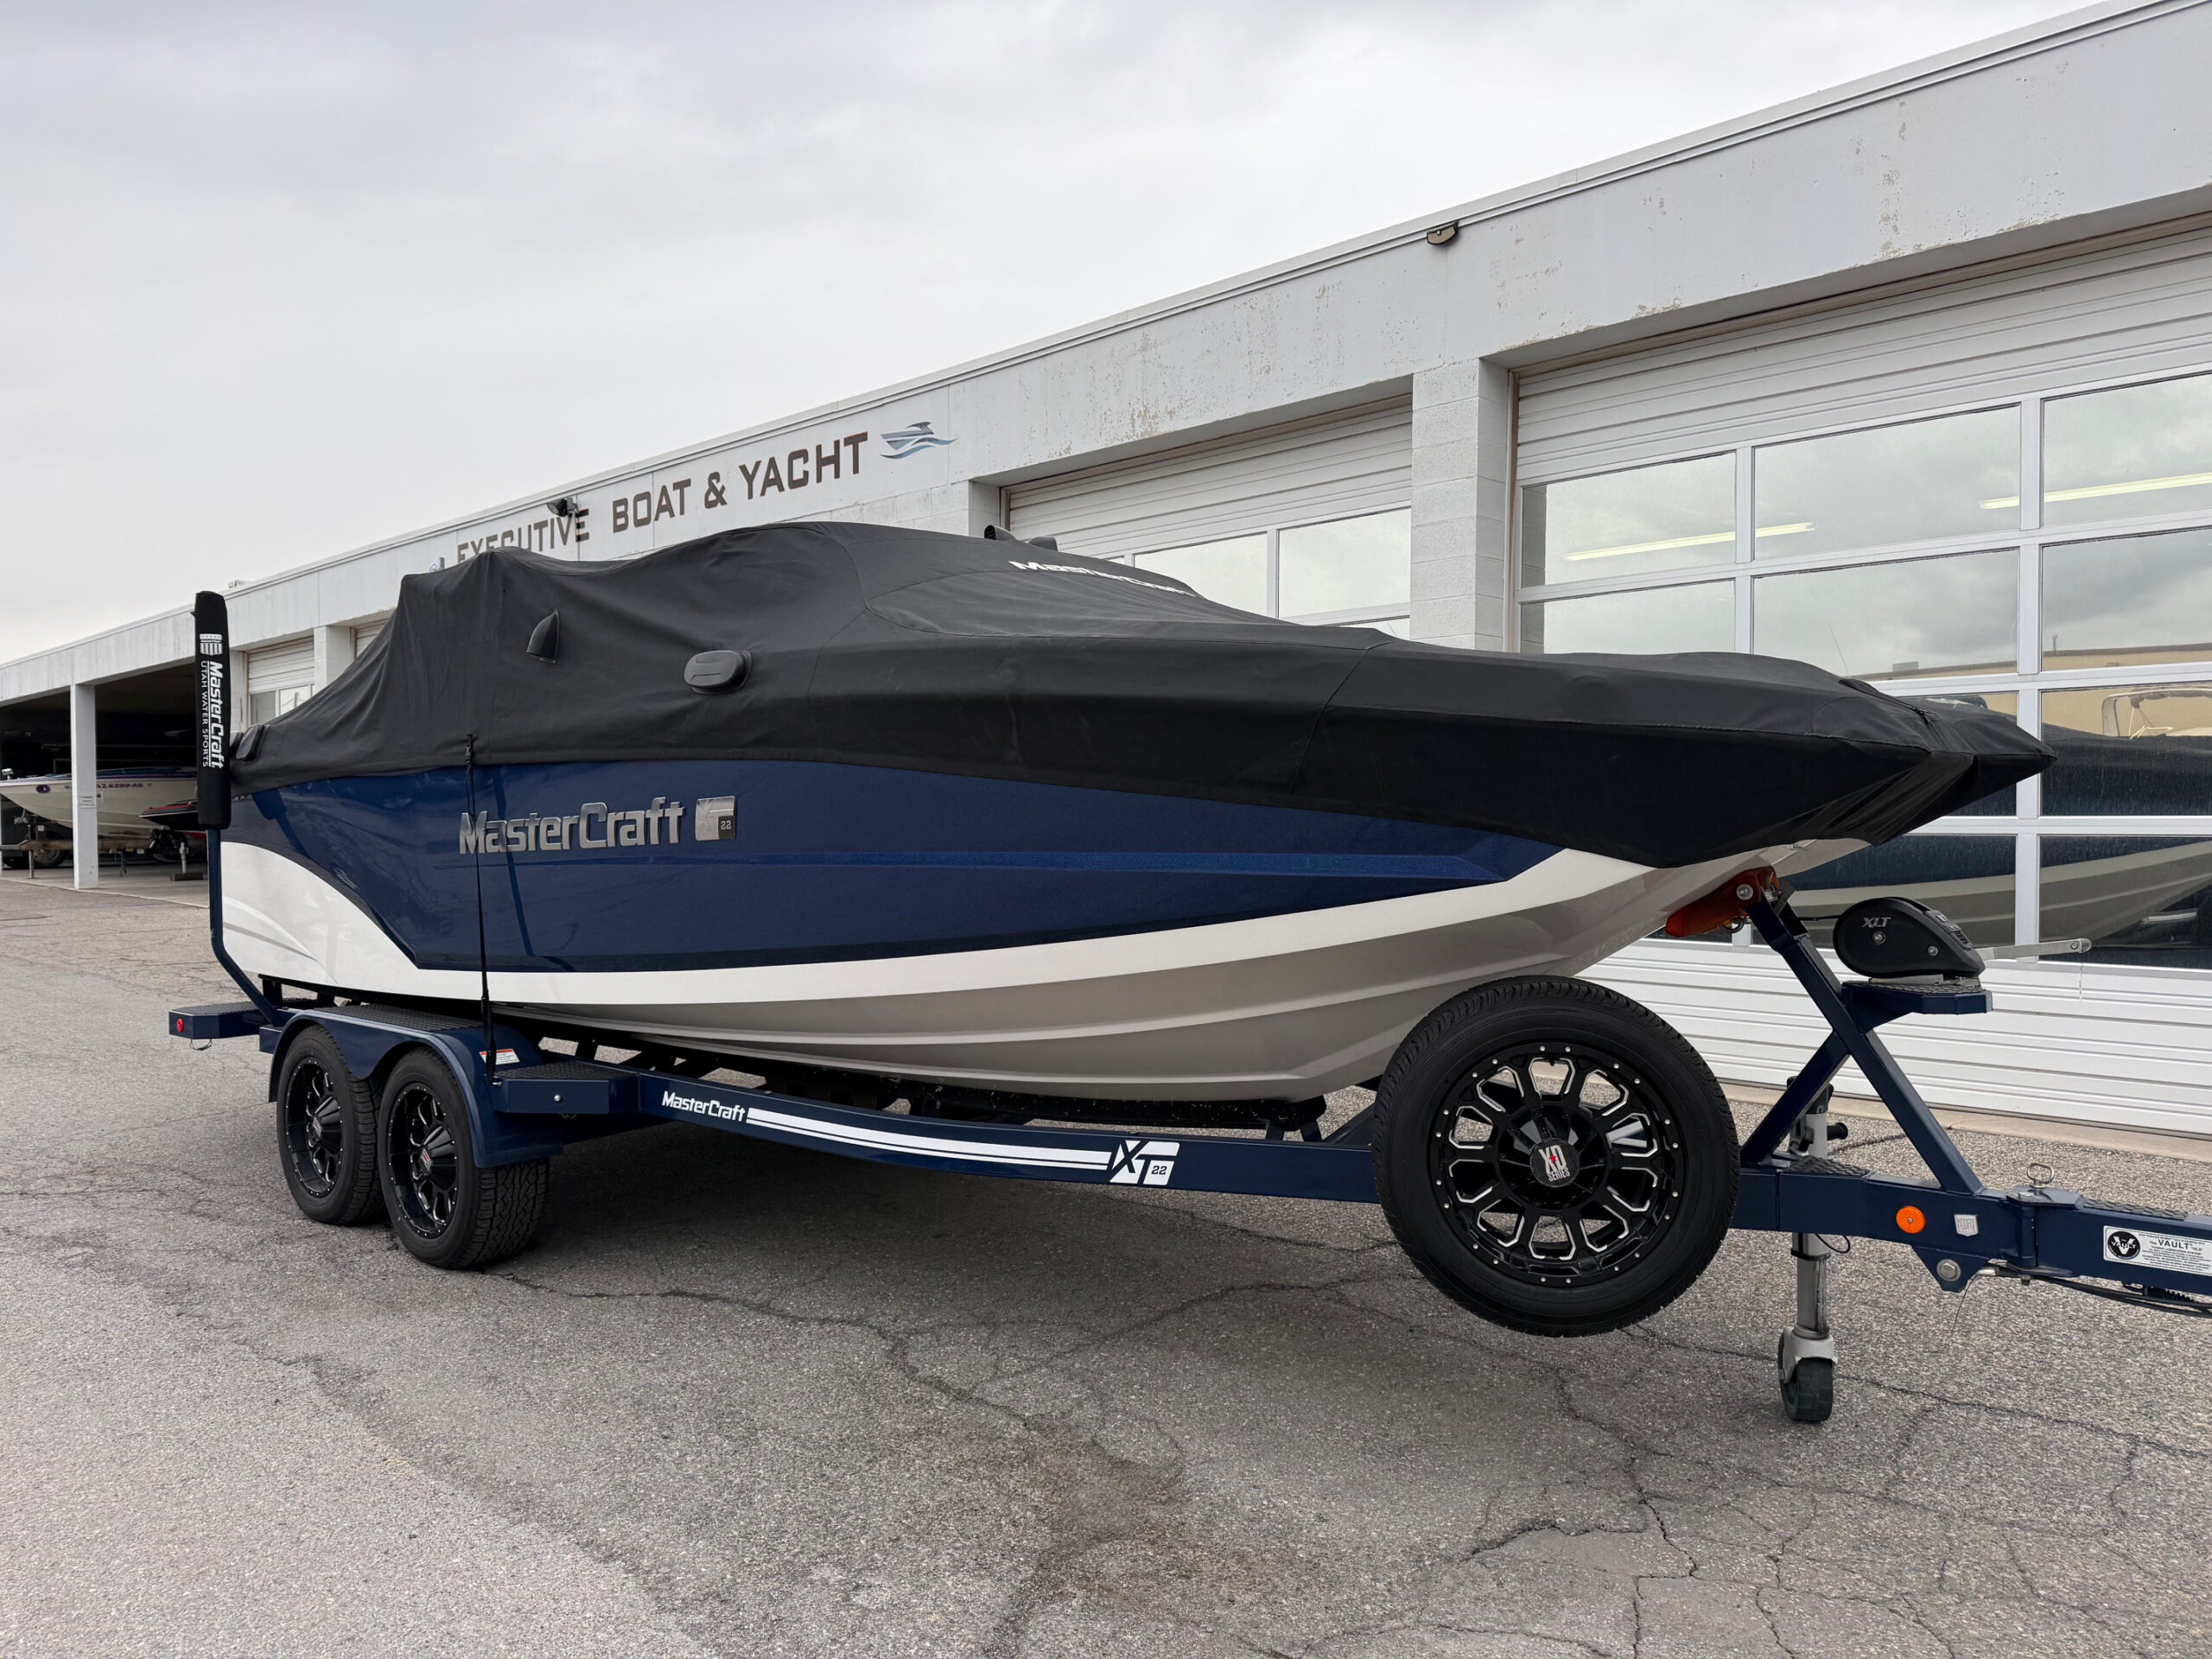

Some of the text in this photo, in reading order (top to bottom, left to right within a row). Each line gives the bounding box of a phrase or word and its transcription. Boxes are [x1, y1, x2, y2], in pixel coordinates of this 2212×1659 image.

[612, 478, 691, 533] BOAT
[704, 472, 728, 509] &
[738, 432, 868, 500] YACHT
[209, 660, 224, 768] MasterCraft
[459, 797, 684, 855] MasterCraft
[721, 820, 732, 830] 22
[1861, 917, 1891, 928] XLT
[661, 1090, 746, 1122] MasterCraft
[1109, 1140, 1180, 1185] XT
[1151, 1165, 1167, 1175] 22
[1538, 1145, 1567, 1174] XD
[1548, 1167, 1570, 1181] SERIES
